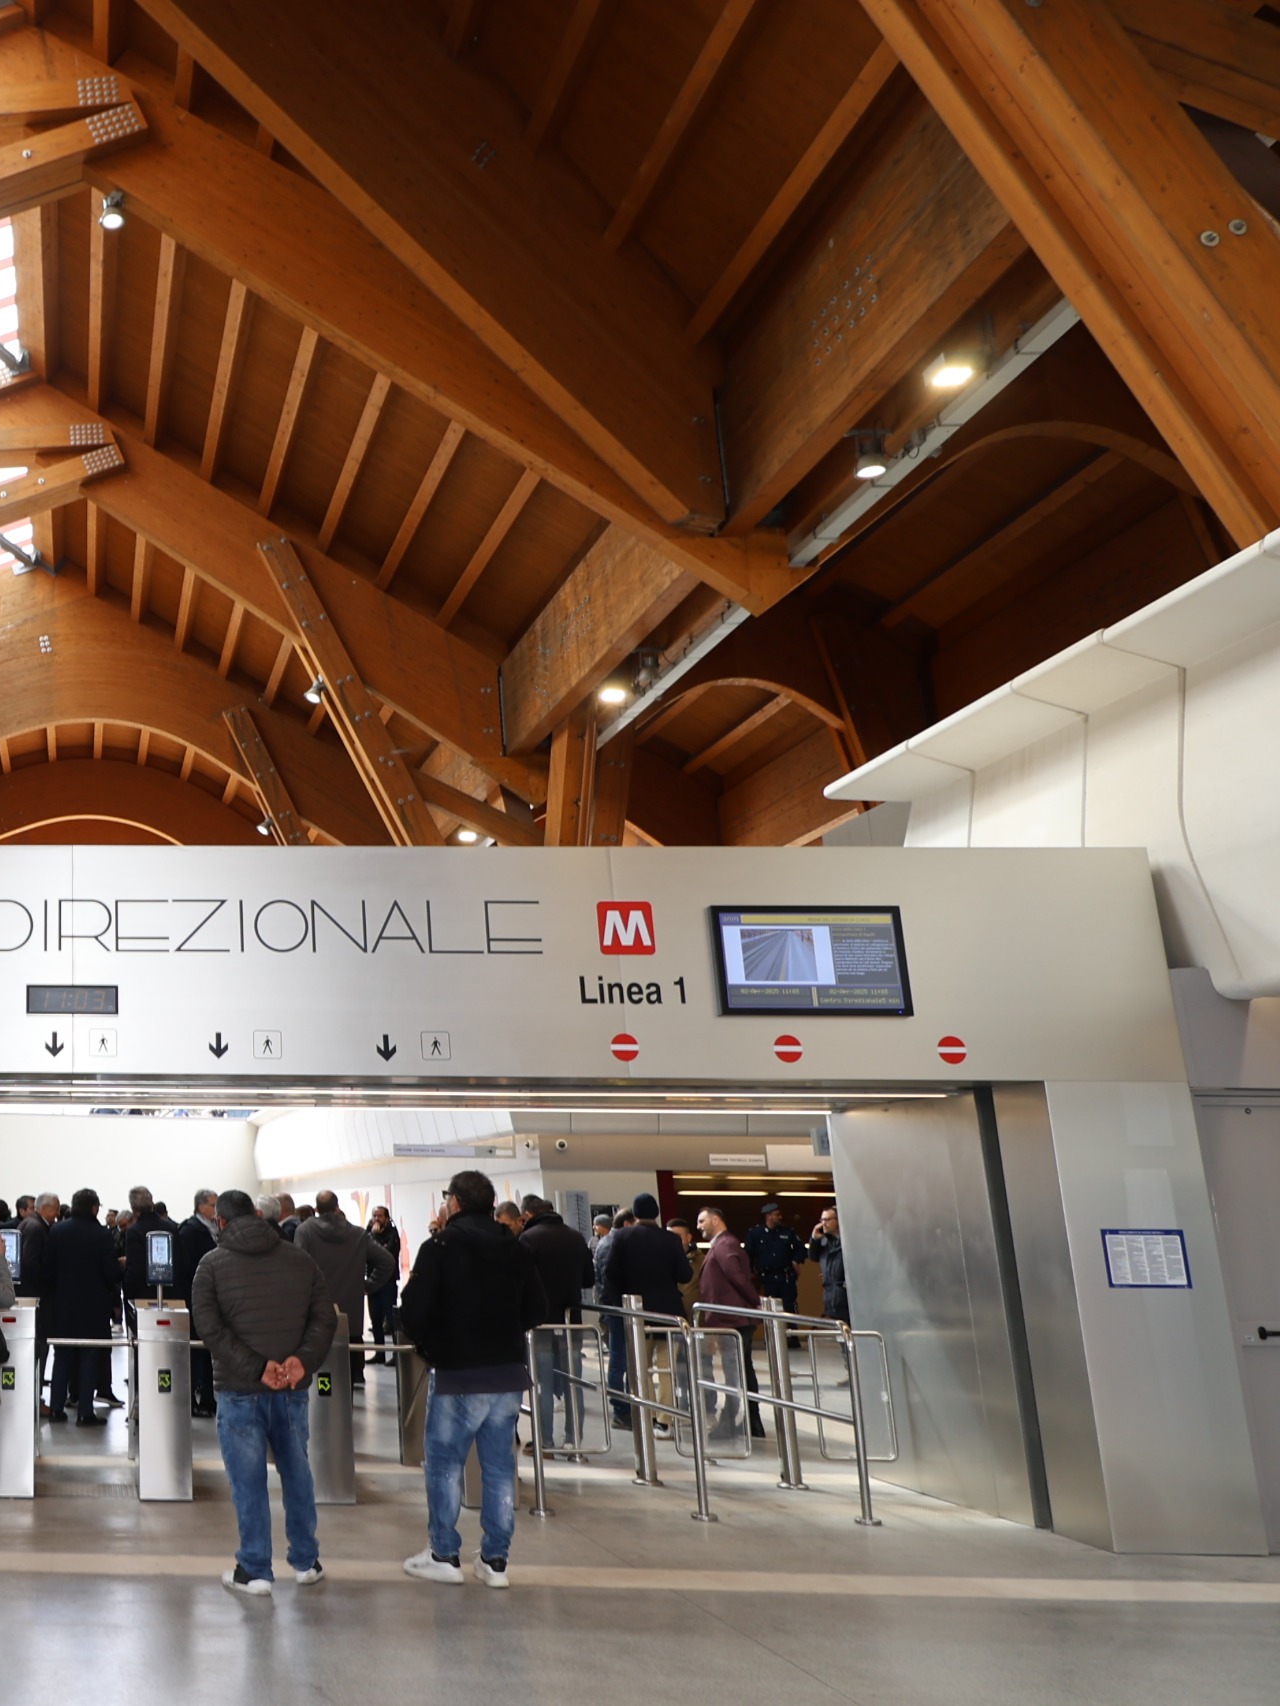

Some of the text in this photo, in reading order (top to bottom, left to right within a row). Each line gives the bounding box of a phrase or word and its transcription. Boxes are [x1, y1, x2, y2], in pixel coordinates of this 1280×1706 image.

[602, 910, 653, 946] M
[579, 975, 687, 1005] Linea 1
